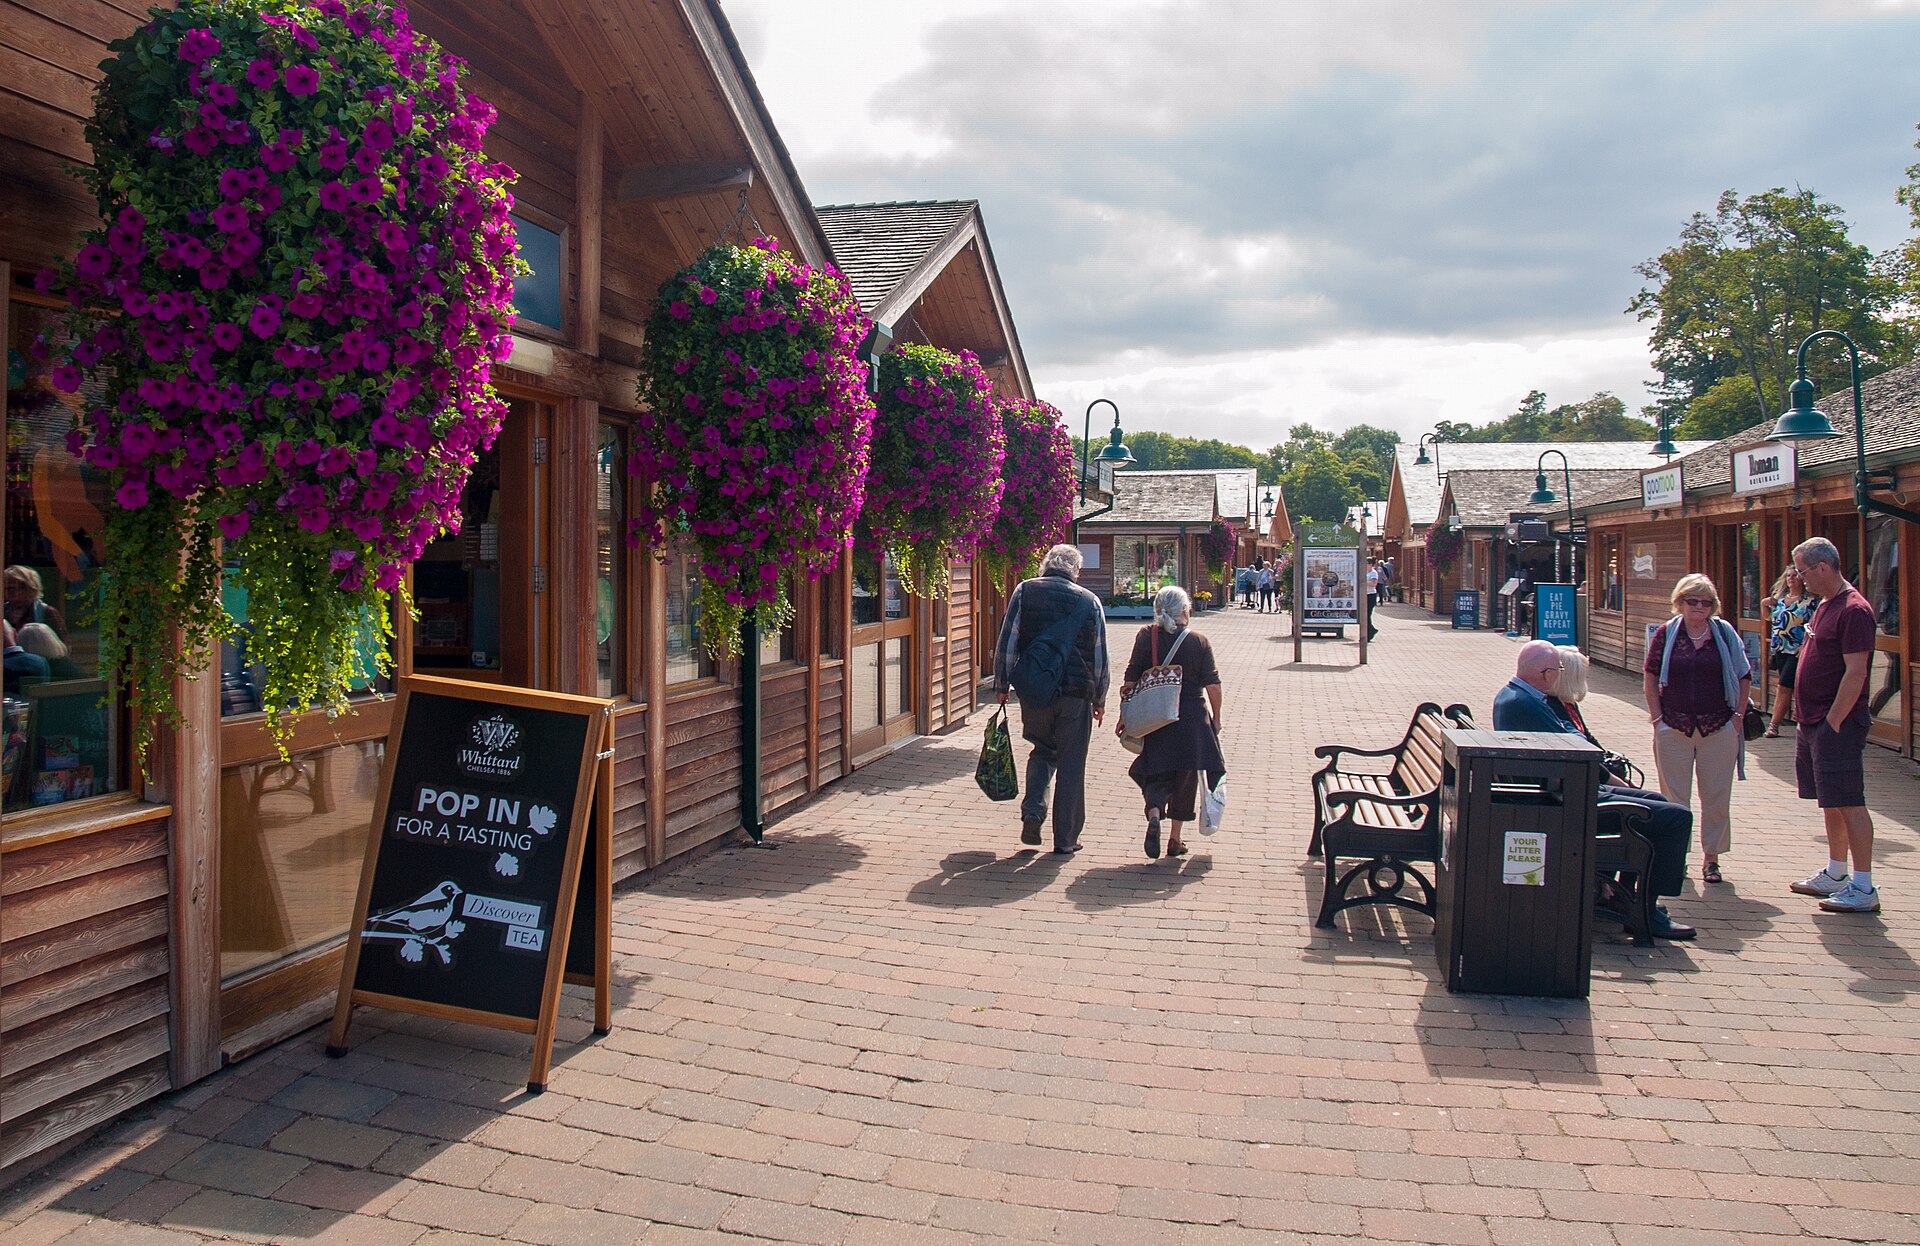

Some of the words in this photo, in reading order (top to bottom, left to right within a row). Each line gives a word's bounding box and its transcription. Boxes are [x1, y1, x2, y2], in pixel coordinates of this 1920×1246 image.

[1750, 474, 1779, 485] ORIGINALS
[1647, 474, 1674, 500] goomoo
[1307, 525, 1331, 533] Toilets
[1318, 534, 1332, 542] Car
[1335, 534, 1352, 542] Park
[1550, 593, 1563, 601] EAT
[1551, 602, 1562, 610] PIE
[1545, 611, 1568, 619] GRAVY
[1544, 620, 1570, 628] REPEAT
[462, 750, 520, 769] Whittard
[466, 765, 495, 773] CHELSEA
[417, 788, 479, 818] POP
[487, 798, 520, 825] IN
[396, 817, 432, 836] FOR
[437, 823, 450, 839] A
[456, 825, 531, 850] TASTING
[1507, 855, 1541, 863] PLEASE
[468, 899, 535, 923] Discover
[512, 930, 539, 946] TEA
